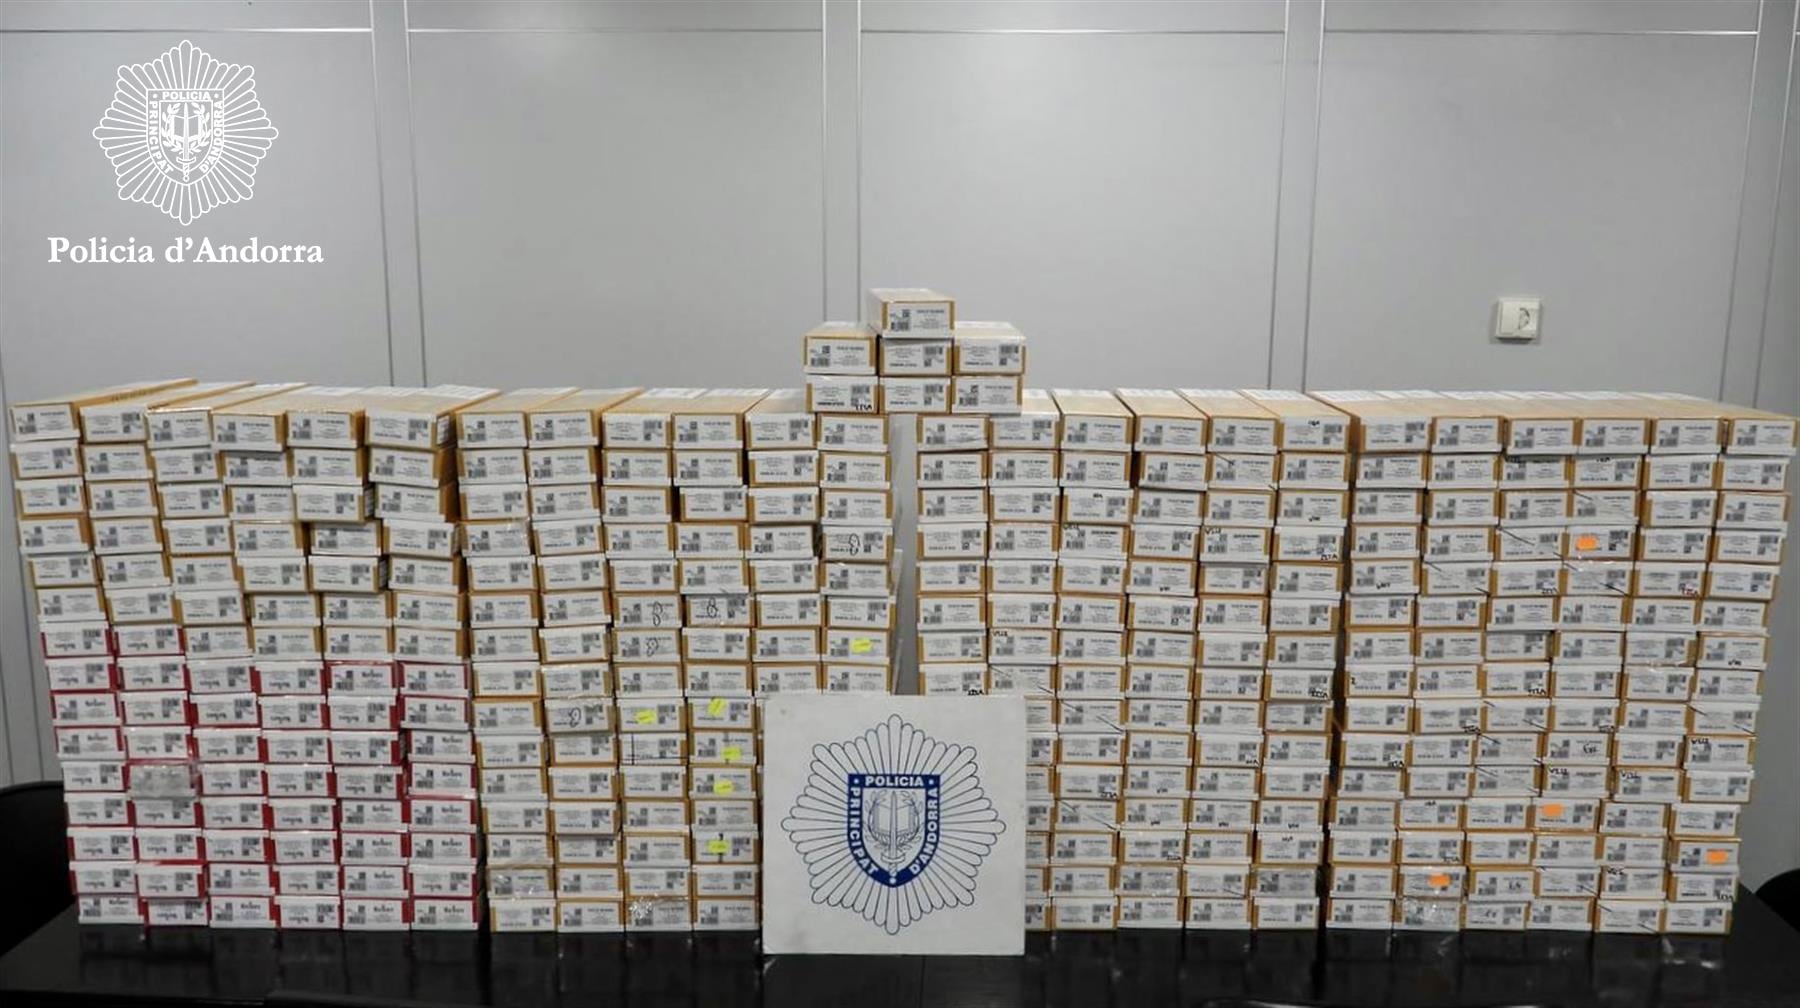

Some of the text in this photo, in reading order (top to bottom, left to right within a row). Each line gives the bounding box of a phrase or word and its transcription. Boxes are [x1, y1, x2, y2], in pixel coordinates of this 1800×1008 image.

[865, 776, 924, 787] POLICIA
[850, 787, 879, 875] PRINCIPAT
[910, 787, 939, 875] D'ANDORRA
